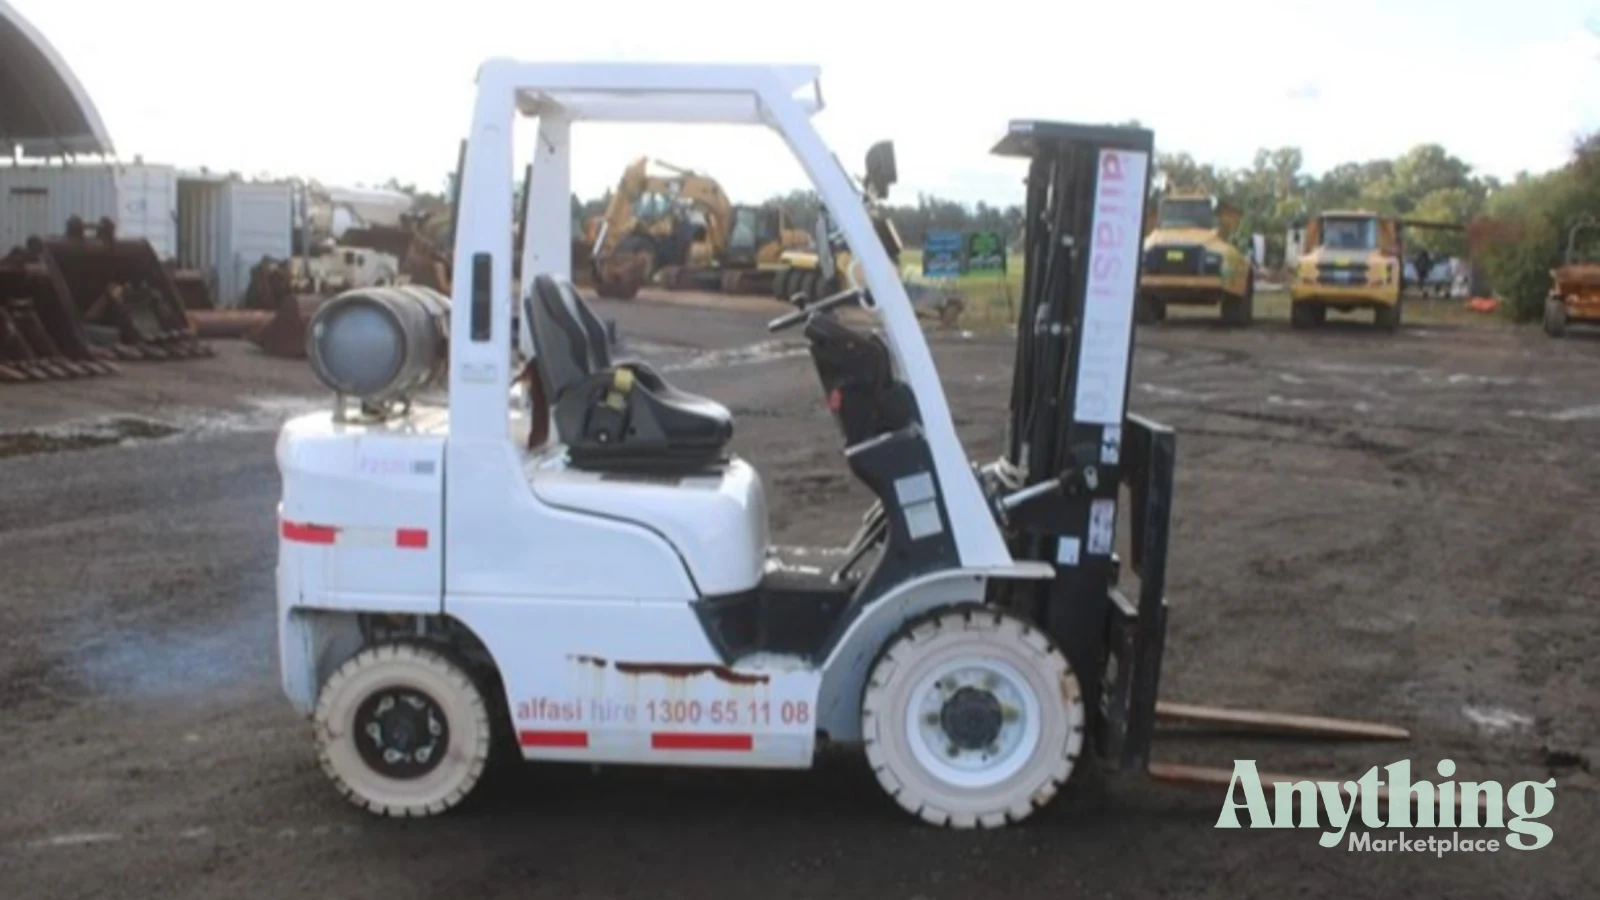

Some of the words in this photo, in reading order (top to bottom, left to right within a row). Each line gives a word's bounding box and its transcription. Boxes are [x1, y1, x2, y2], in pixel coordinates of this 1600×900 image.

[1091, 152, 1138, 297] alfasi
[517, 697, 582, 721] alfasi
[590, 698, 637, 723] hire
[646, 699, 701, 723] 1300
[710, 700, 738, 724] 55
[748, 701, 770, 725] 11
[780, 701, 809, 725] 08
